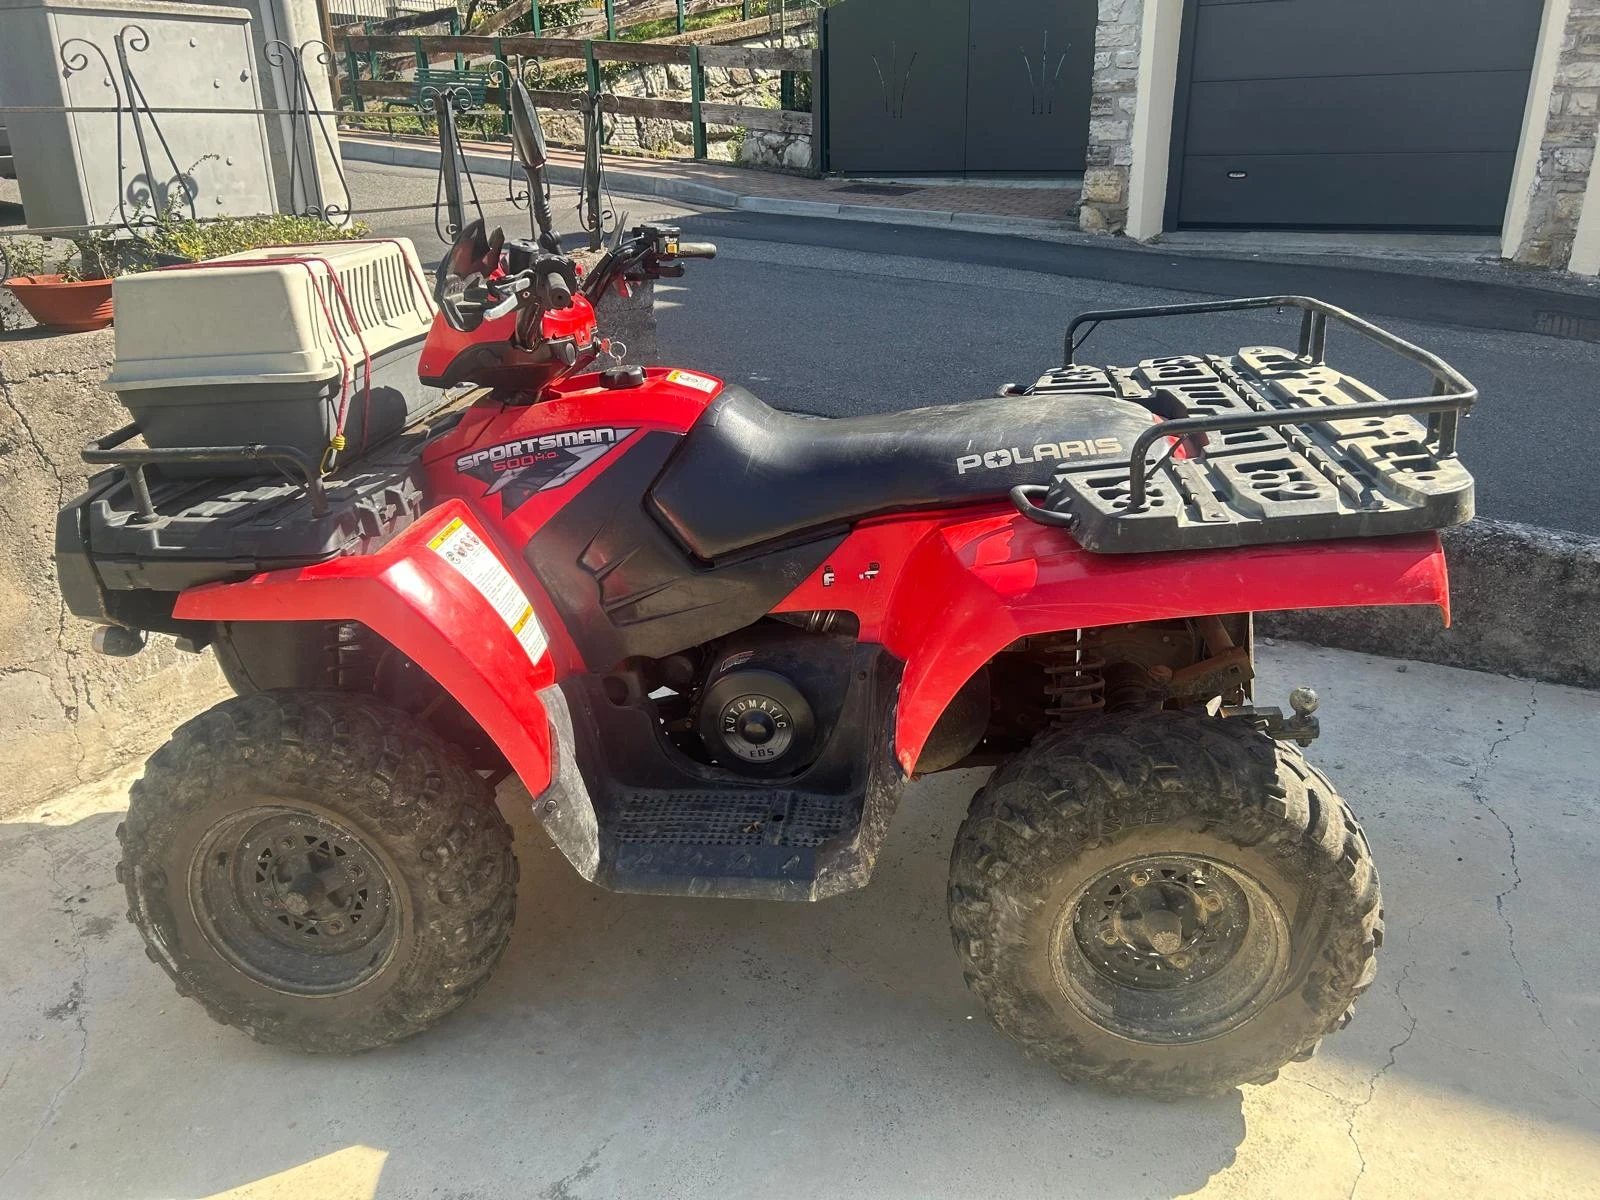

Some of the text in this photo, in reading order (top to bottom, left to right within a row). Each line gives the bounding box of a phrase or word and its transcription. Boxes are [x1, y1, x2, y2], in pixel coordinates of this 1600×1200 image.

[457, 428, 615, 472] SPORTSMAN
[956, 437, 1123, 475] POLARIS
[725, 699, 787, 733] AUTOMATIC
[750, 747, 775, 758] EBS
